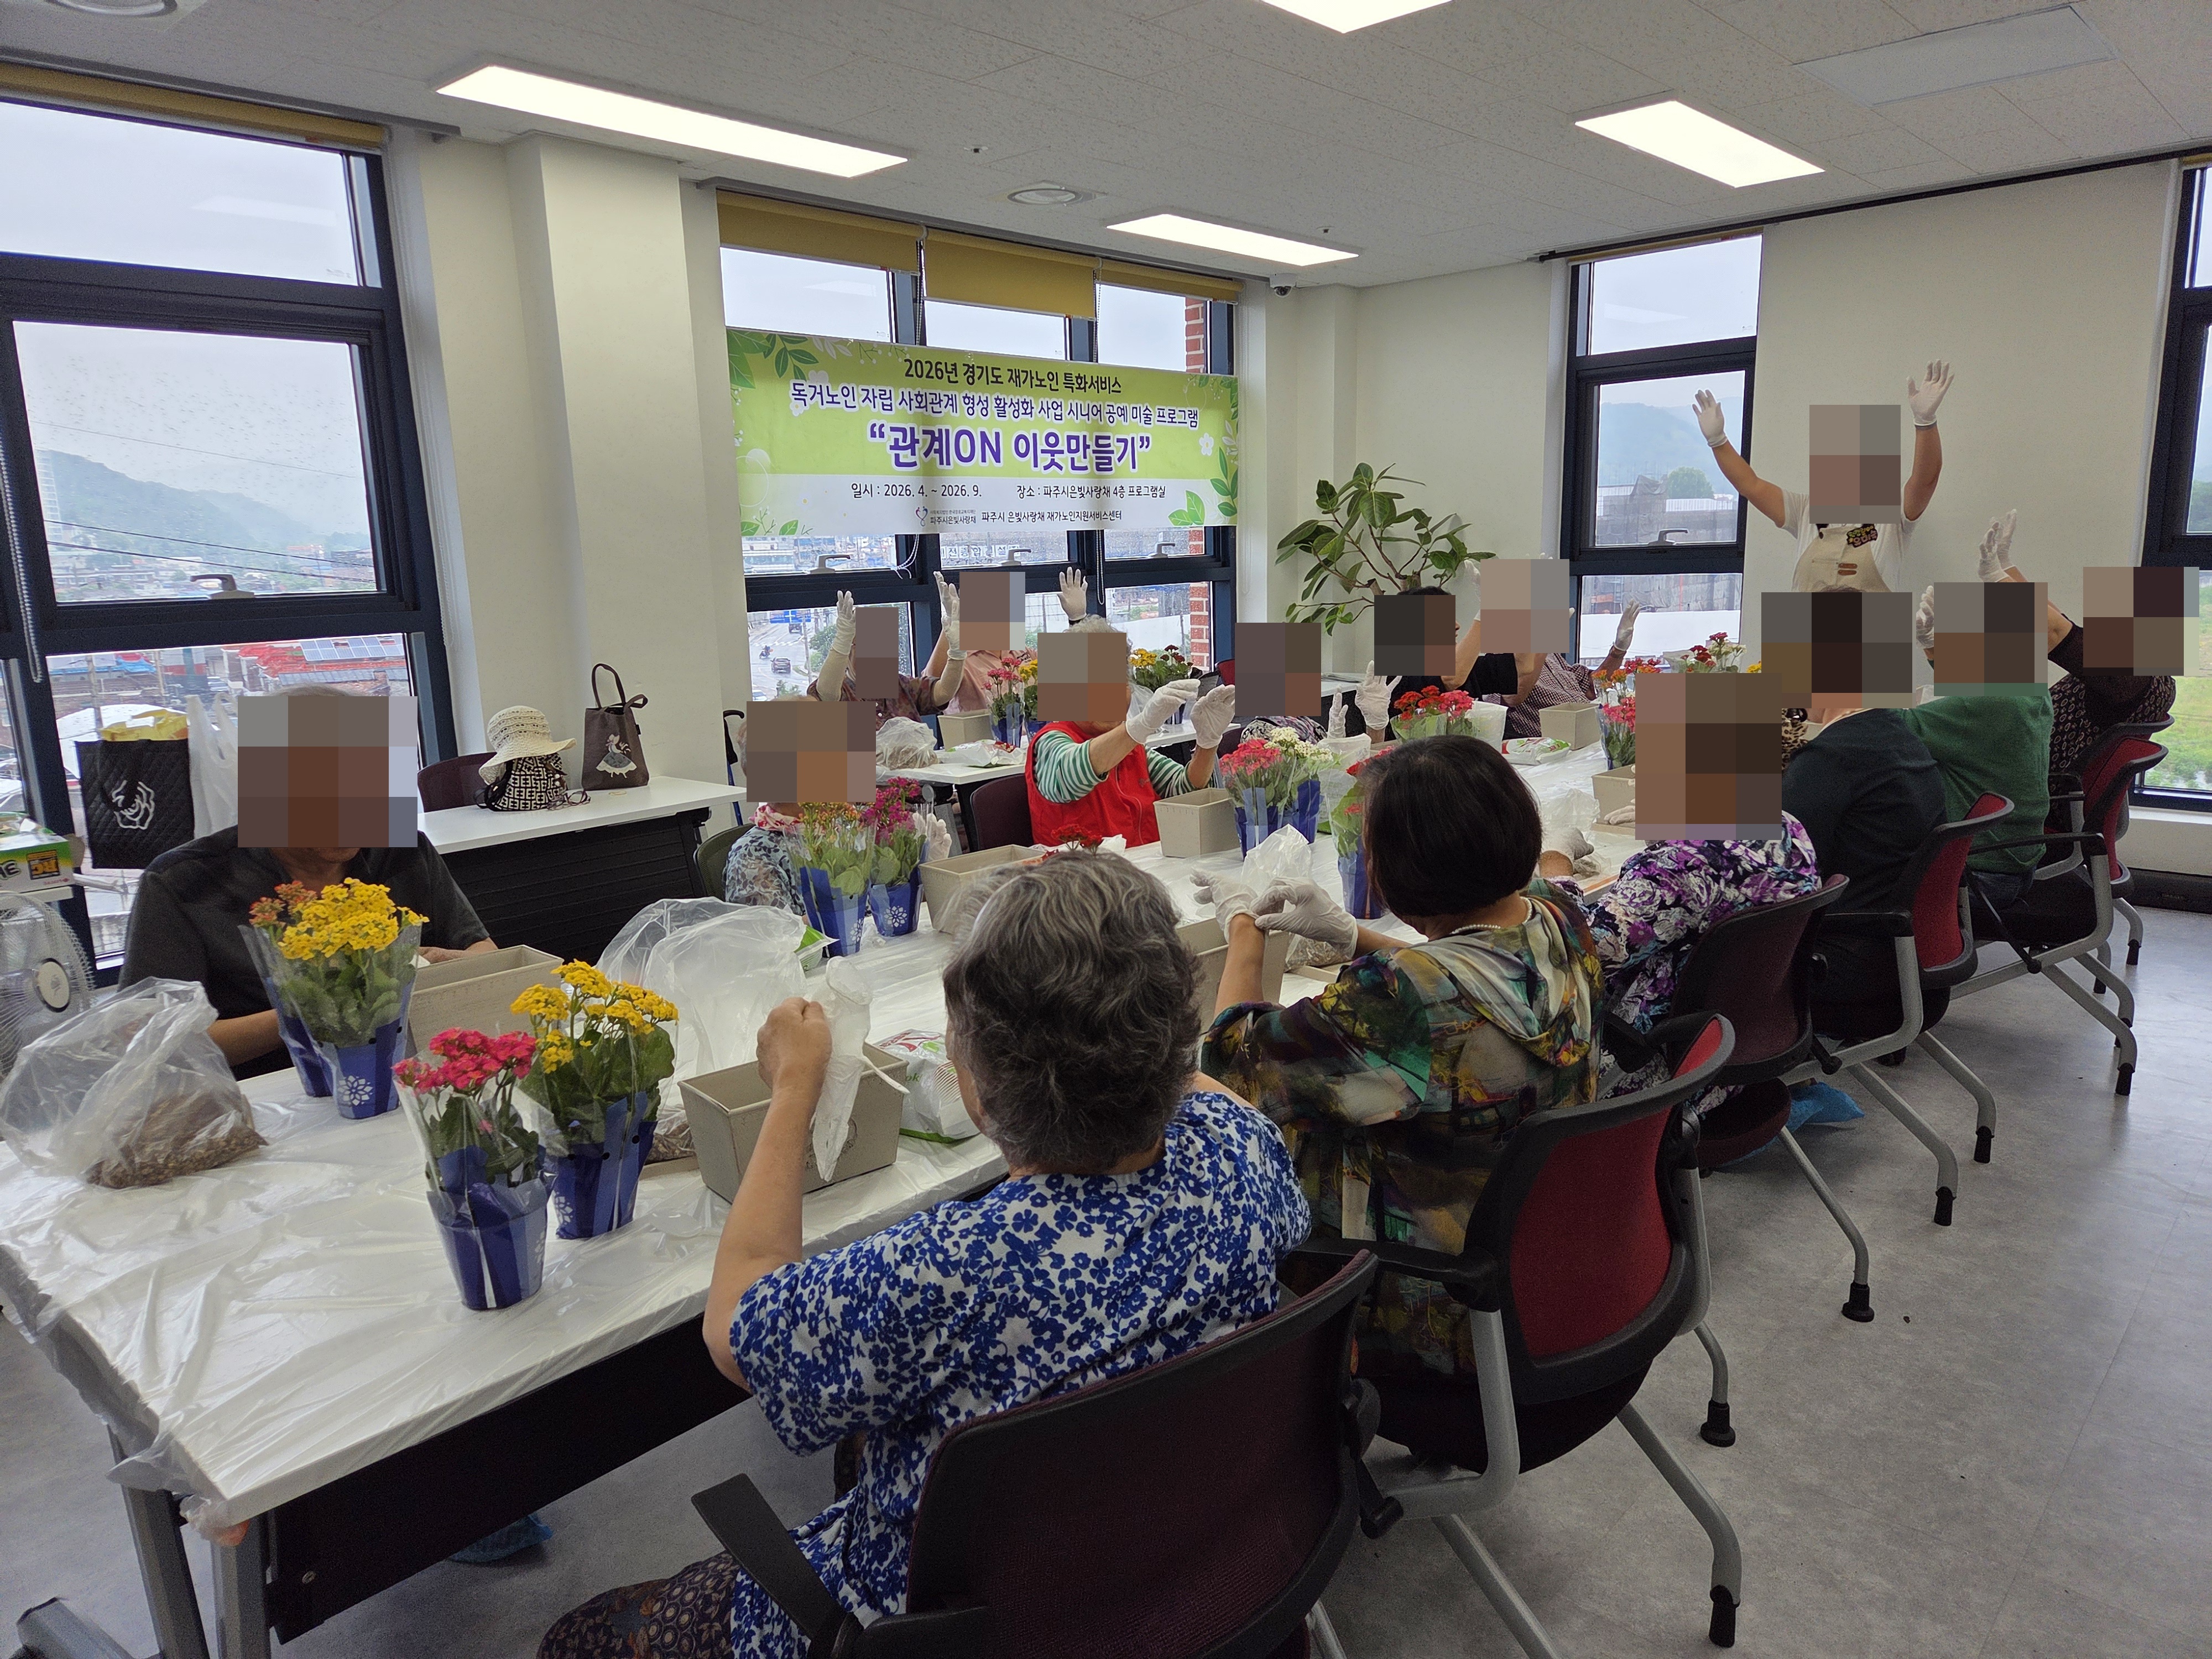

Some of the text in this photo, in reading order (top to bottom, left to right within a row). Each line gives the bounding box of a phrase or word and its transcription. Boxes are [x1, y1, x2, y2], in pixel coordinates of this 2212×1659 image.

[904, 358, 1121, 394] 2026년 경기도 재가노인 특화서비스
[791, 382, 1198, 428] 독거노인 자립 사회관계 형성 활성화 사업 시니어 공예 미술 프로그램
[851, 483, 873, 498] 일시
[884, 484, 915, 497] 2026.
[918, 484, 928, 497] 4.
[941, 484, 969, 497] 2026.
[972, 484, 982, 497] 9.
[1016, 485, 1035, 499] 장소
[1043, 485, 1110, 499] 파주시은빛사랑채
[1113, 485, 1125, 498] 4층
[1128, 485, 1166, 498] 프로그램실
[930, 515, 976, 525] 파주시은빛사랑채
[982, 510, 1122, 523] 파주시 은빛사랑채 재가노인지원서비스센터
